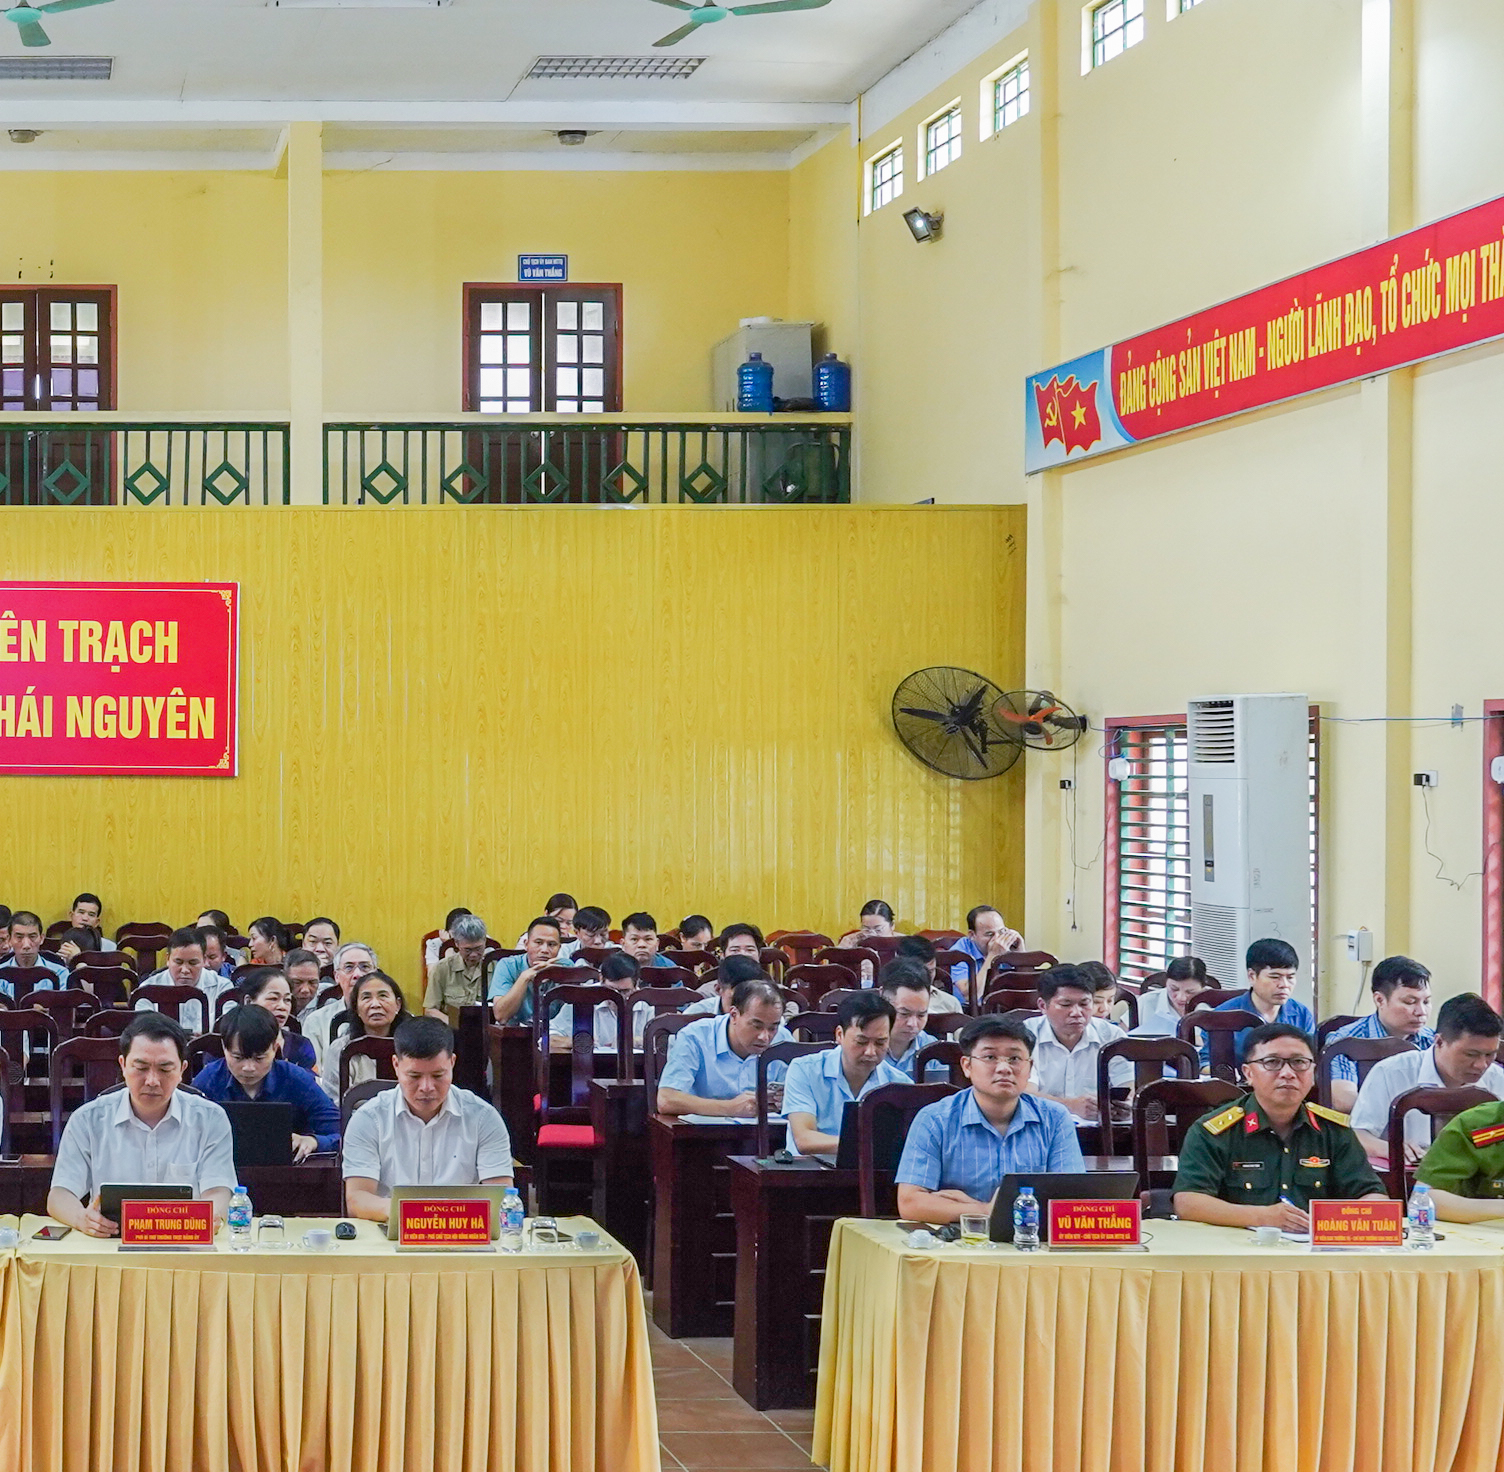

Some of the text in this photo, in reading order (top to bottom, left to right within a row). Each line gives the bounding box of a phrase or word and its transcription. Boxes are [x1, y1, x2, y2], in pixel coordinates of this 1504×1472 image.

[1120, 350, 1146, 416] ĐẢNG
[1149, 350, 1176, 416] CỘNG
[1179, 328, 1201, 398] SẢN
[1204, 329, 1226, 398] VIỆT
[1229, 326, 1256, 382] NAM
[1259, 347, 1264, 357] -
[1267, 298, 1304, 371] NGƯỜI
[1308, 293, 1342, 358] LÃNH
[1345, 286, 1376, 355] ĐẠO,
[1380, 254, 1398, 335] TỔ
[1402, 249, 1441, 329] CHỨC
[1446, 249, 1475, 323] MỌI
[59, 621, 178, 672] TRẠCH
[66, 687, 215, 739] NGUYÊN
[129, 1217, 206, 1232] PHẠM TRUNG DŨNG
[406, 1214, 446, 1229] NGUYỄN
[449, 1218, 468, 1229] HUY
[471, 1215, 484, 1229] HÀ
[1058, 1213, 1131, 1228] VŨ VĂN THẮNG
[1317, 1218, 1348, 1231] HOÀNG
[1351, 1218, 1369, 1231] VĂN
